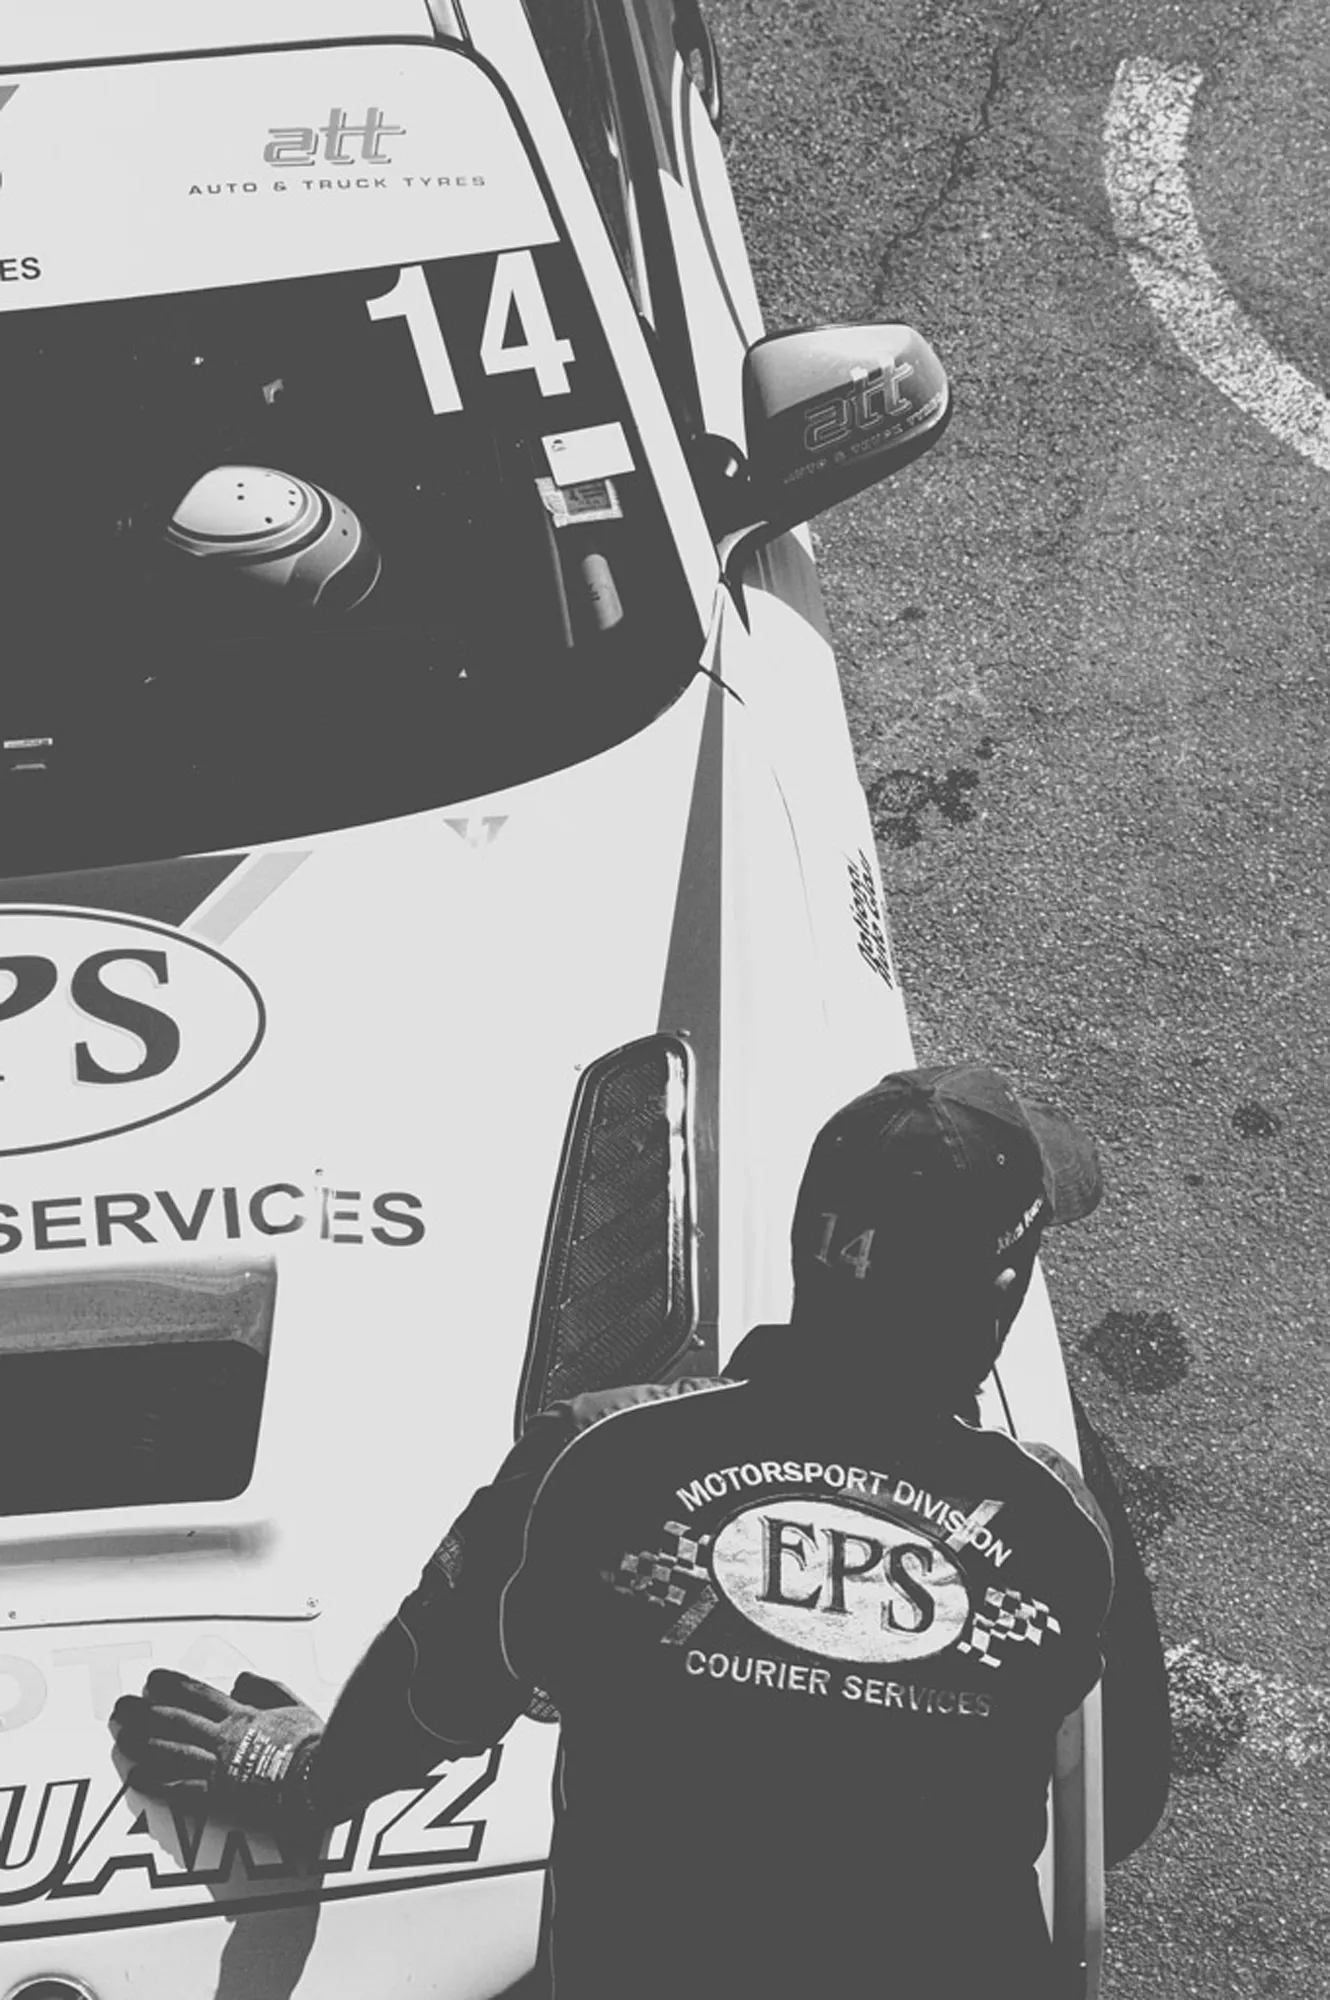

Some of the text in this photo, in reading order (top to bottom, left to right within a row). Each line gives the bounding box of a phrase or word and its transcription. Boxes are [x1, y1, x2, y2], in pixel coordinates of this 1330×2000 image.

[262, 107, 406, 167] att
[188, 175, 486, 196] AUTO & TRUCK TYRES
[365, 249, 576, 415] 14
[814, 1212, 876, 1280] 14
[676, 1461, 1013, 1568] MOTORSPORT DIVISION
[756, 1515, 935, 1635] EPS
[685, 1650, 992, 1718] COURIER SERVICES
